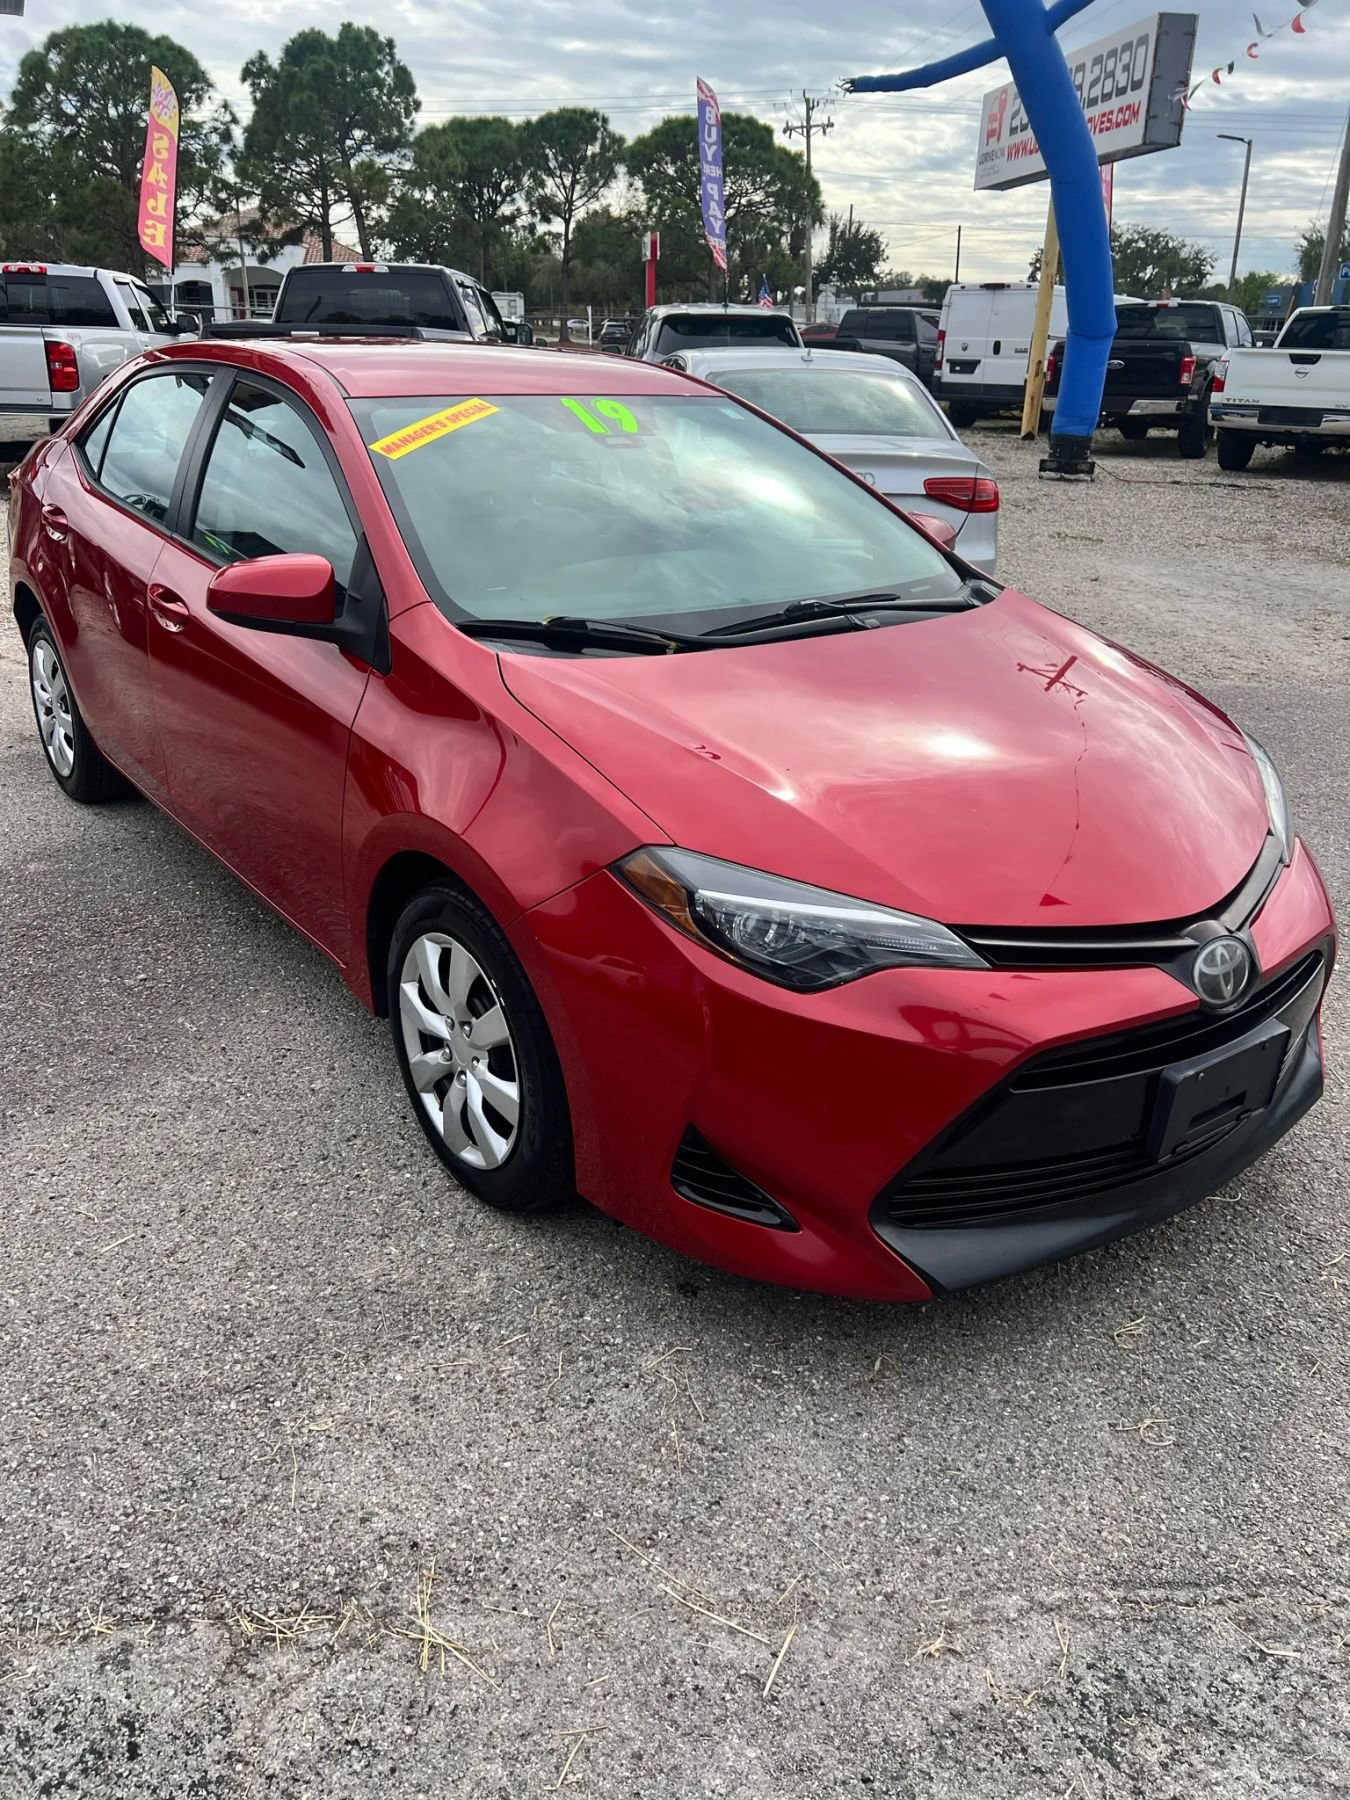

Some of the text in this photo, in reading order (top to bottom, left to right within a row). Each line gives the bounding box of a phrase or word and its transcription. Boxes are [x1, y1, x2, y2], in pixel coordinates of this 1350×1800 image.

[380, 402, 493, 456] MANAGER'S SPECIAL
[559, 397, 639, 434] 19
